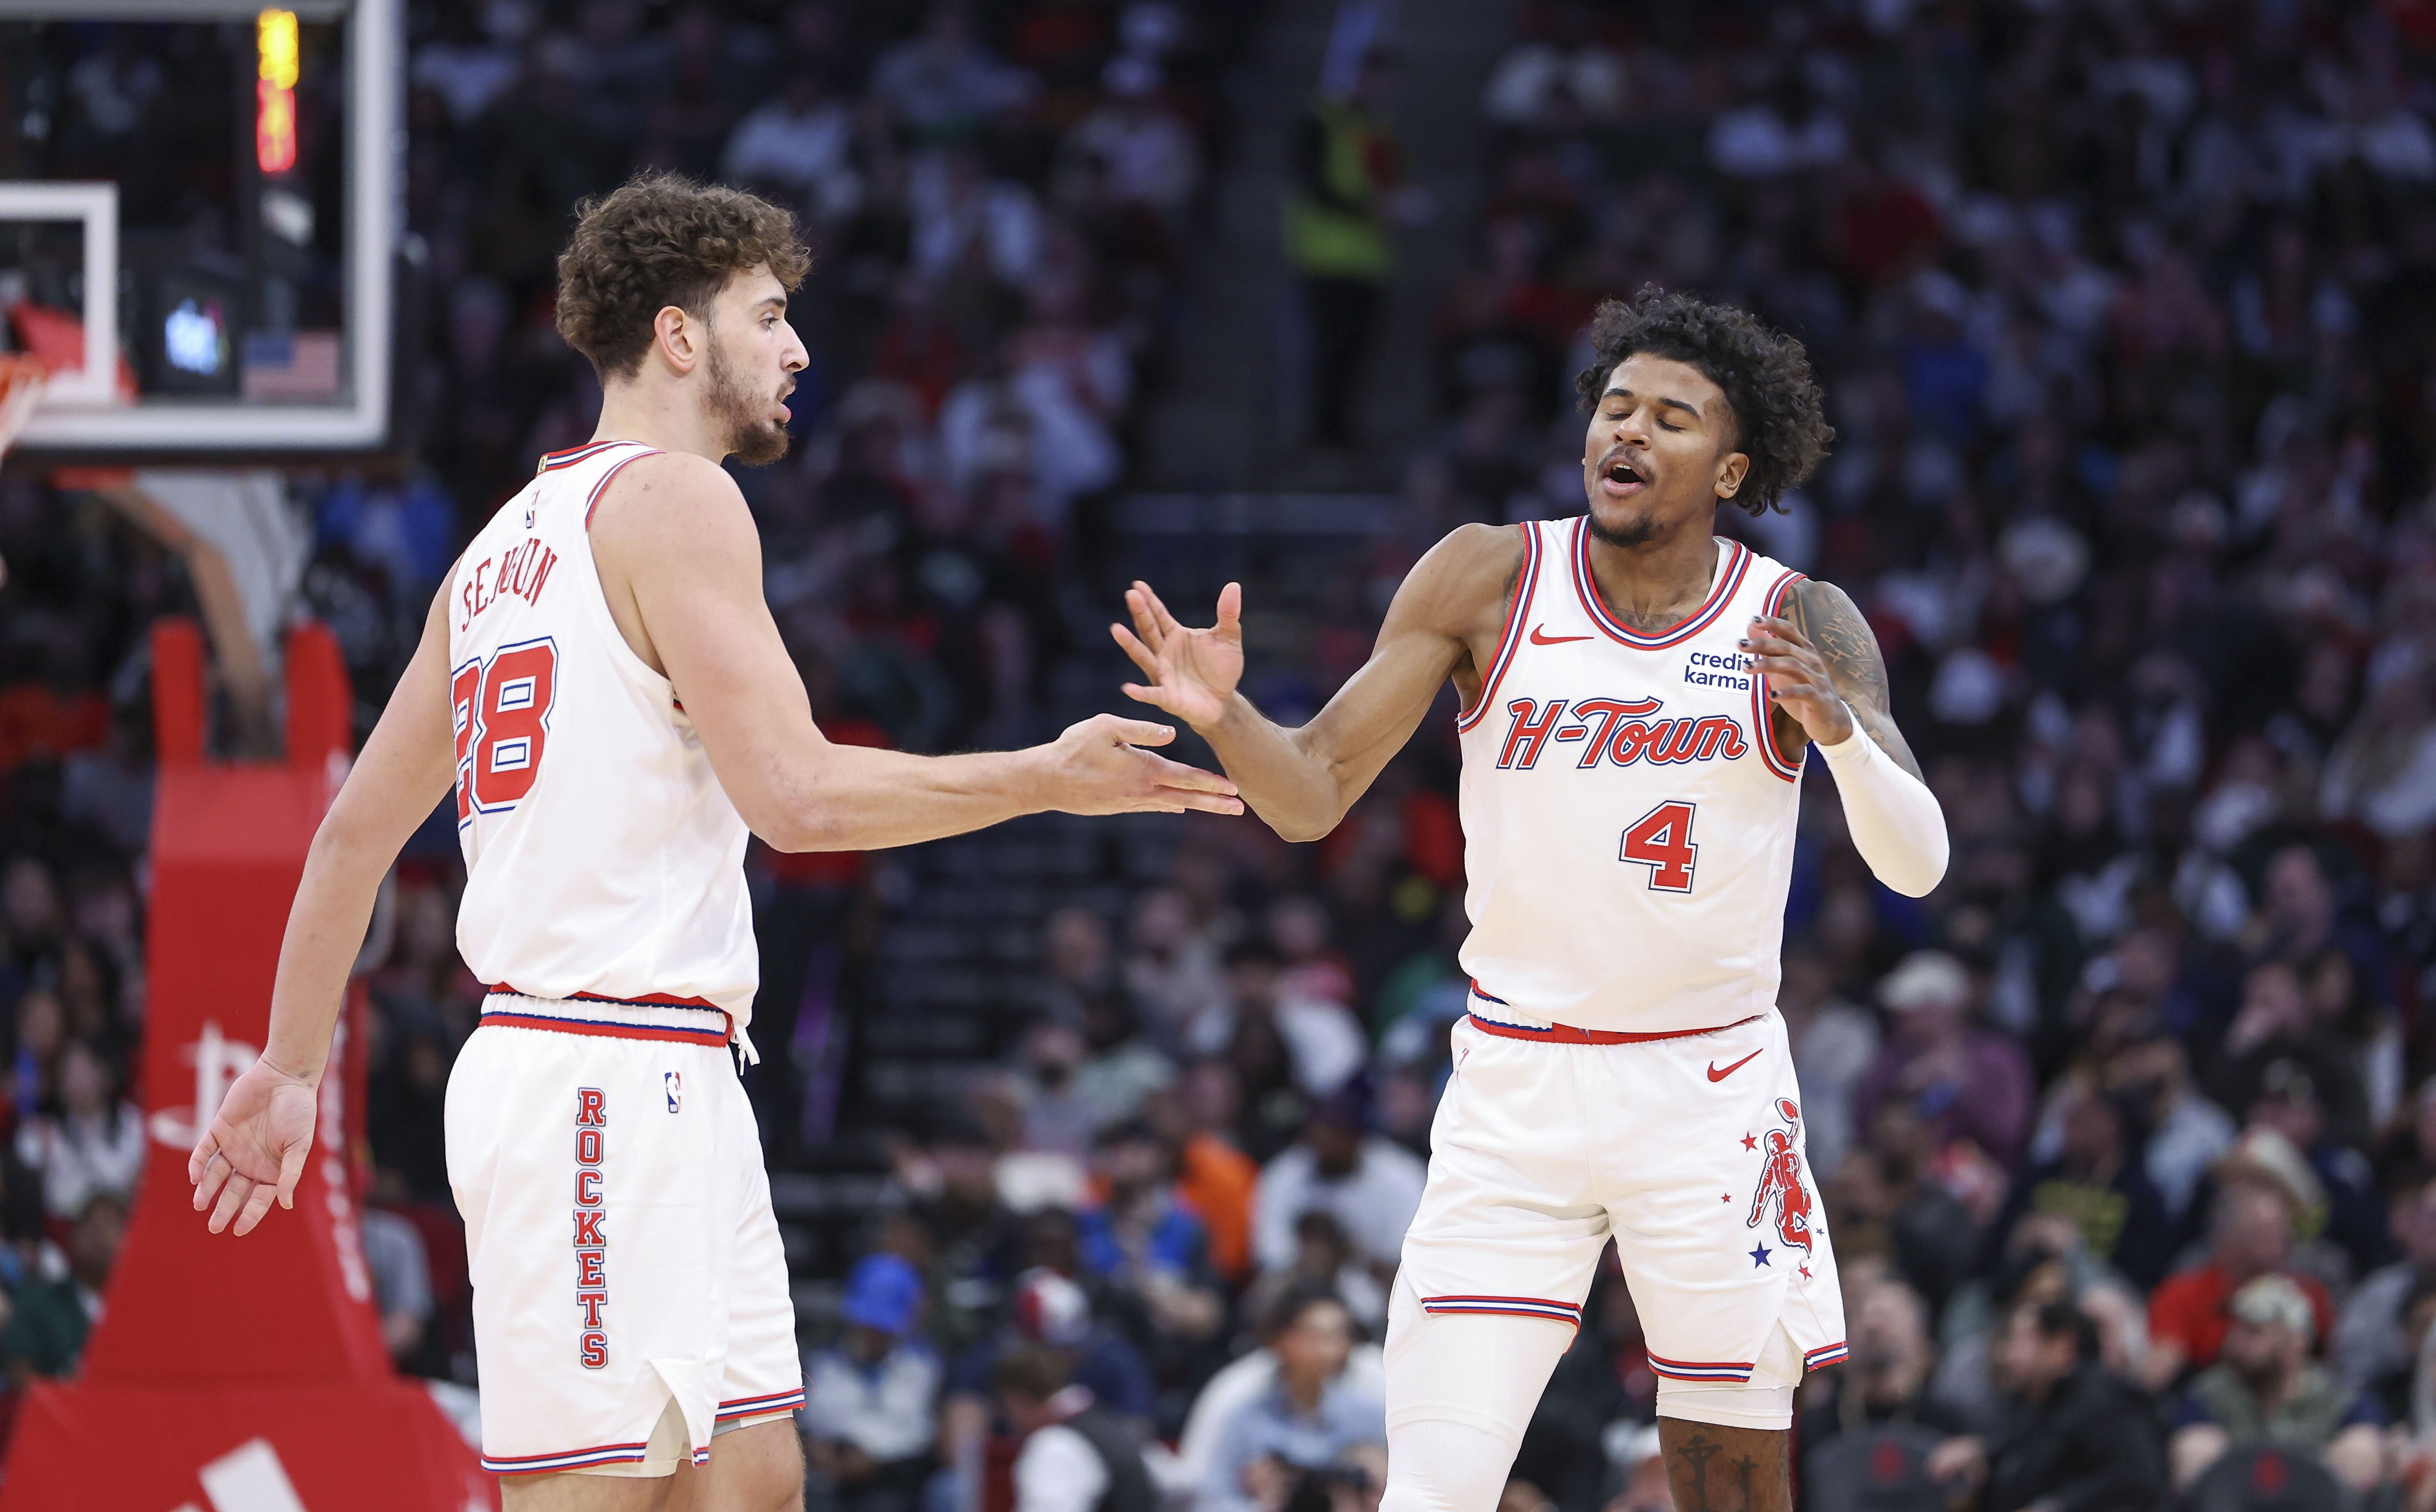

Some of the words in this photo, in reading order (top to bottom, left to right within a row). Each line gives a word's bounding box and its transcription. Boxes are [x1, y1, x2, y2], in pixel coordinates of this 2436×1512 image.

[1684, 665, 1749, 691] karma
[1495, 696, 1748, 770] H-Town
[1618, 799, 1699, 894] 4
[573, 1087, 608, 1369] ROCKETS
